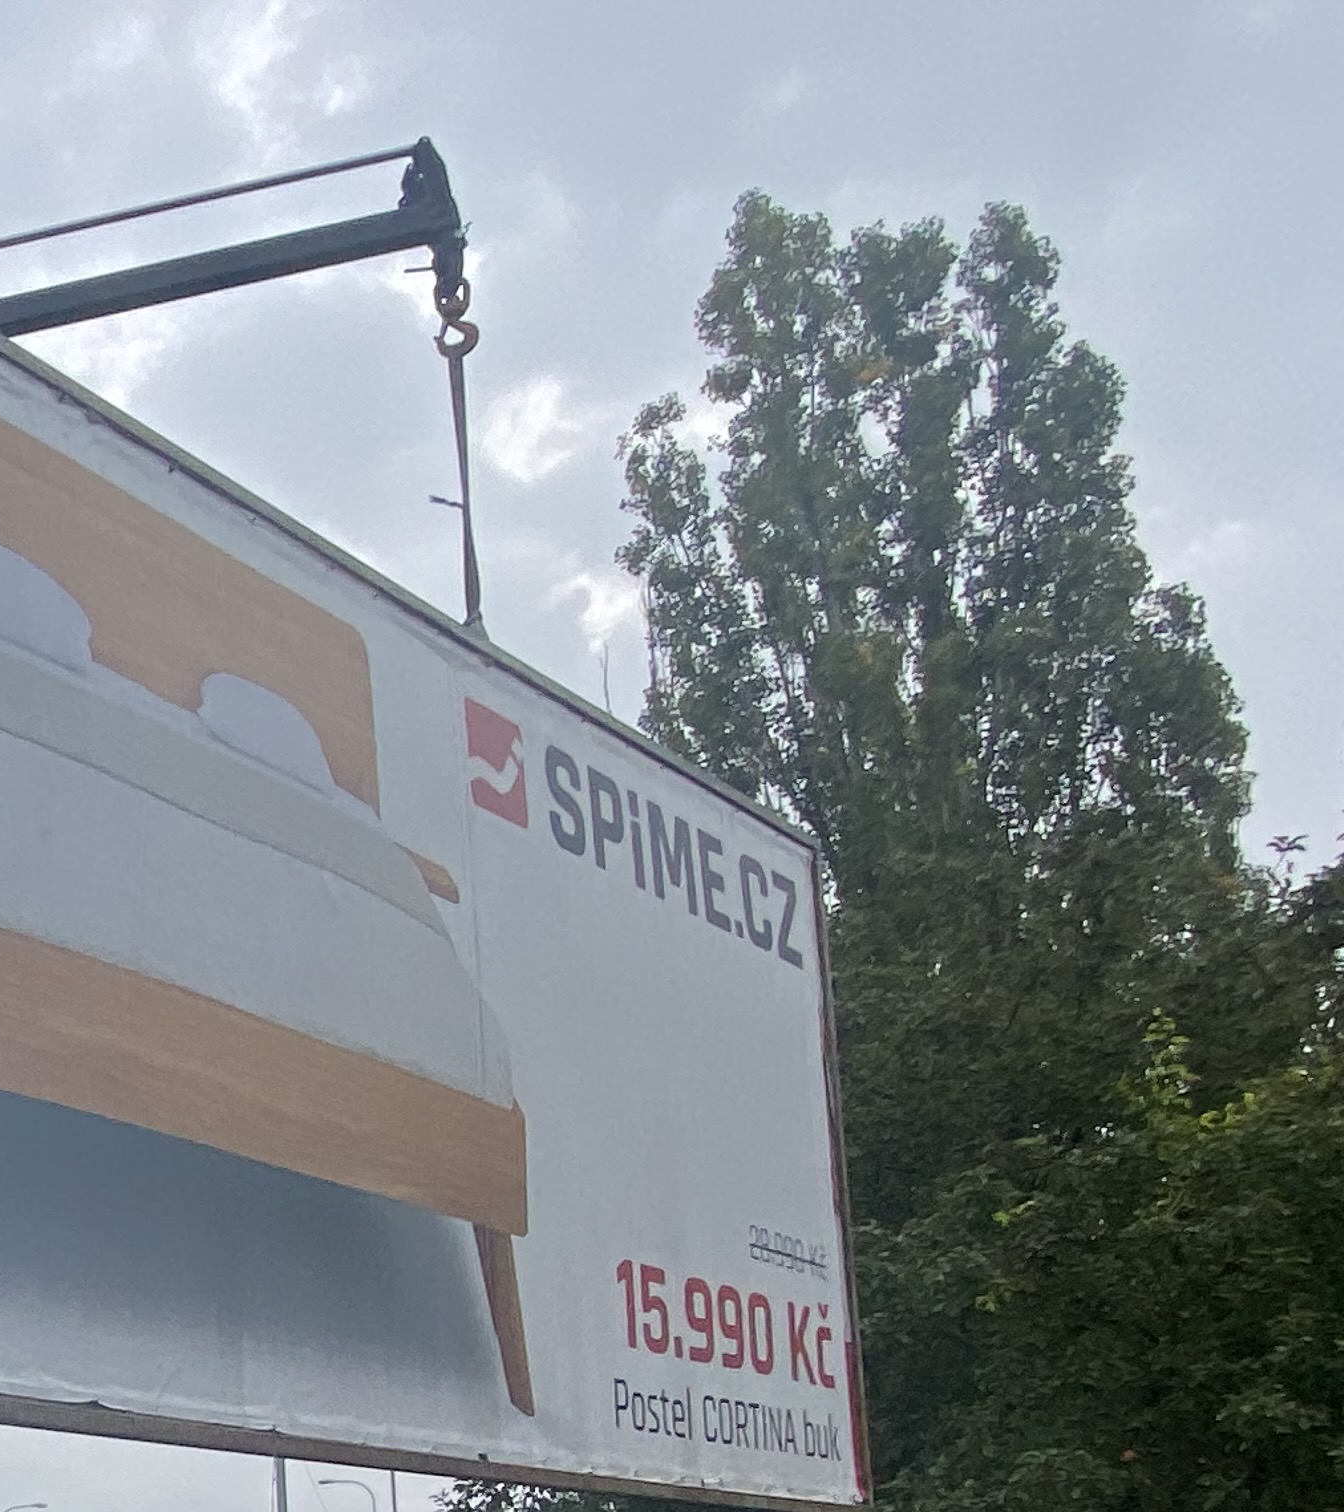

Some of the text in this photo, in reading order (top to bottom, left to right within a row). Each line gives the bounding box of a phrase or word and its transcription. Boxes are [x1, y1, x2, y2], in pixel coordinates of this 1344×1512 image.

[616, 1259, 836, 1389] 15.990 Kč
[613, 1378, 842, 1462] Postel CORTINA buk
